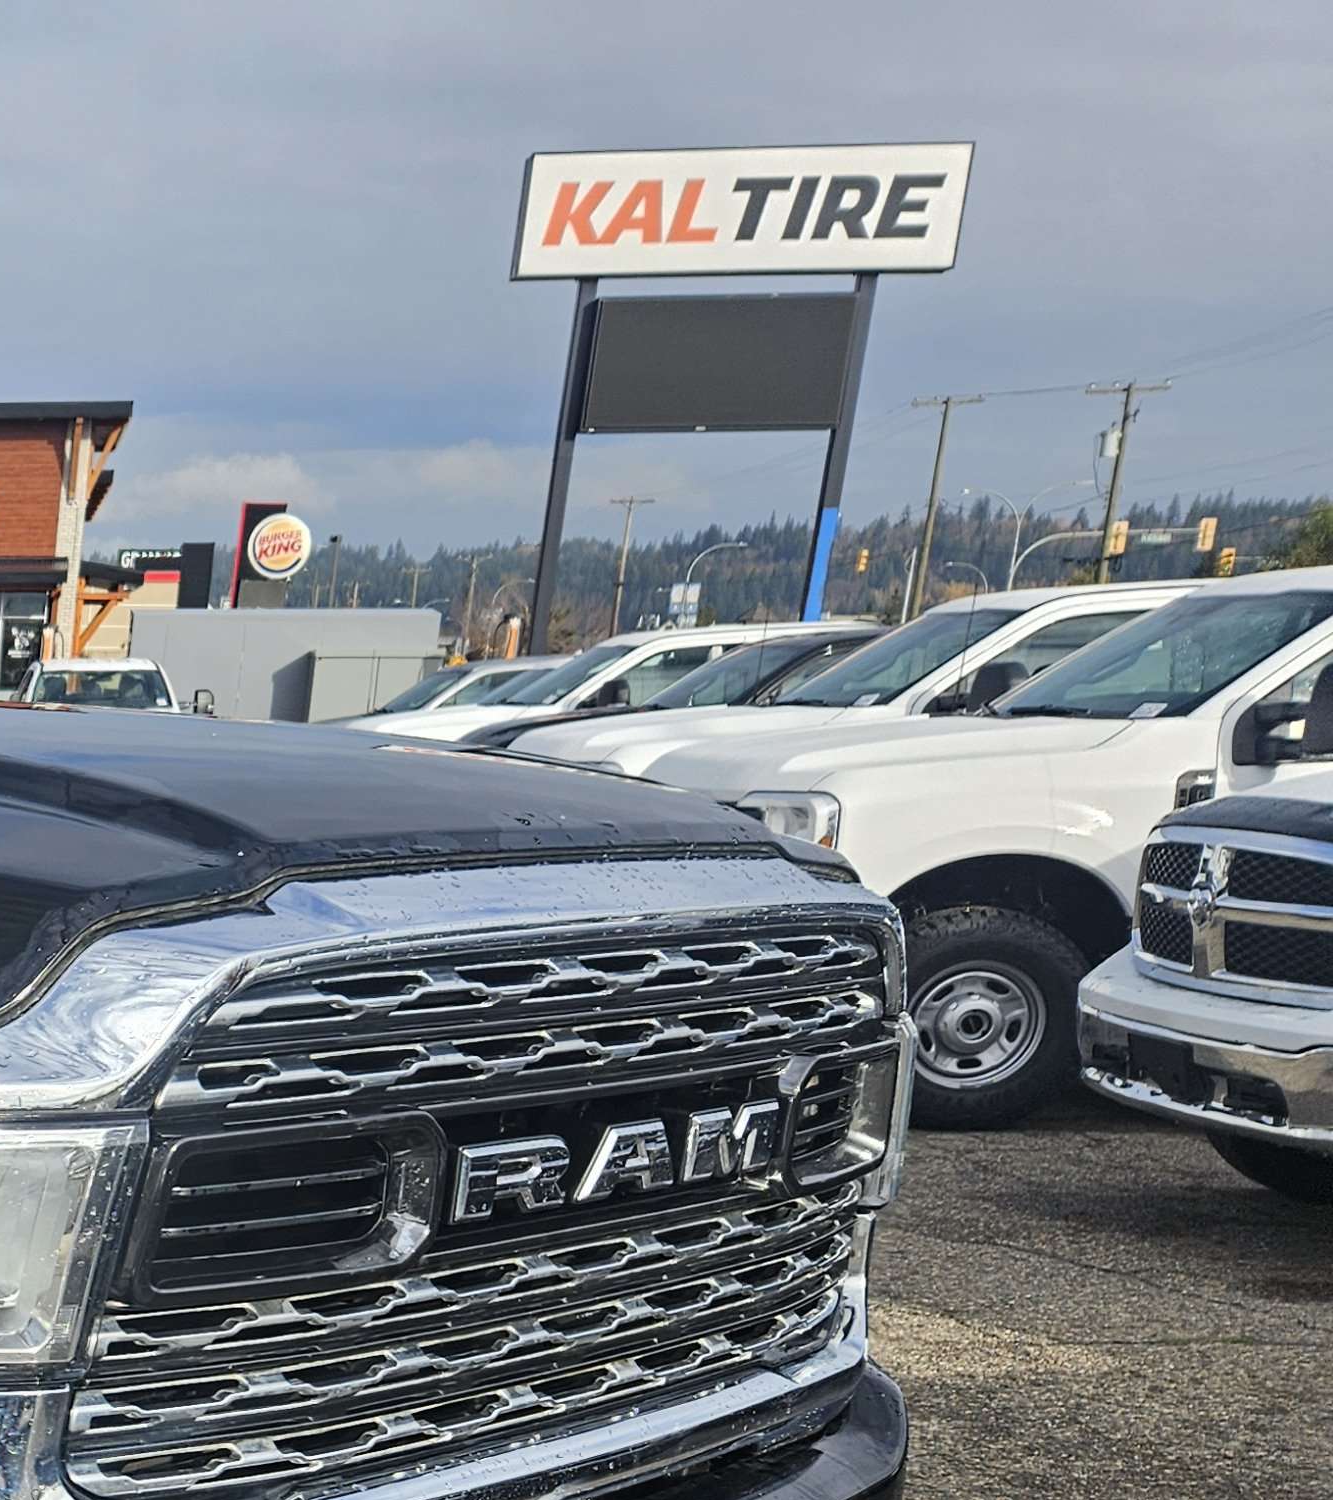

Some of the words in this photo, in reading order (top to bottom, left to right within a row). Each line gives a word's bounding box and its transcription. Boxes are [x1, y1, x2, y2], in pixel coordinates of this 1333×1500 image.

[541, 178, 718, 247] KAL
[731, 172, 949, 242] TIRE
[257, 539, 302, 560] KING
[259, 529, 302, 547] BURGER
[449, 1099, 780, 1225] RAM
